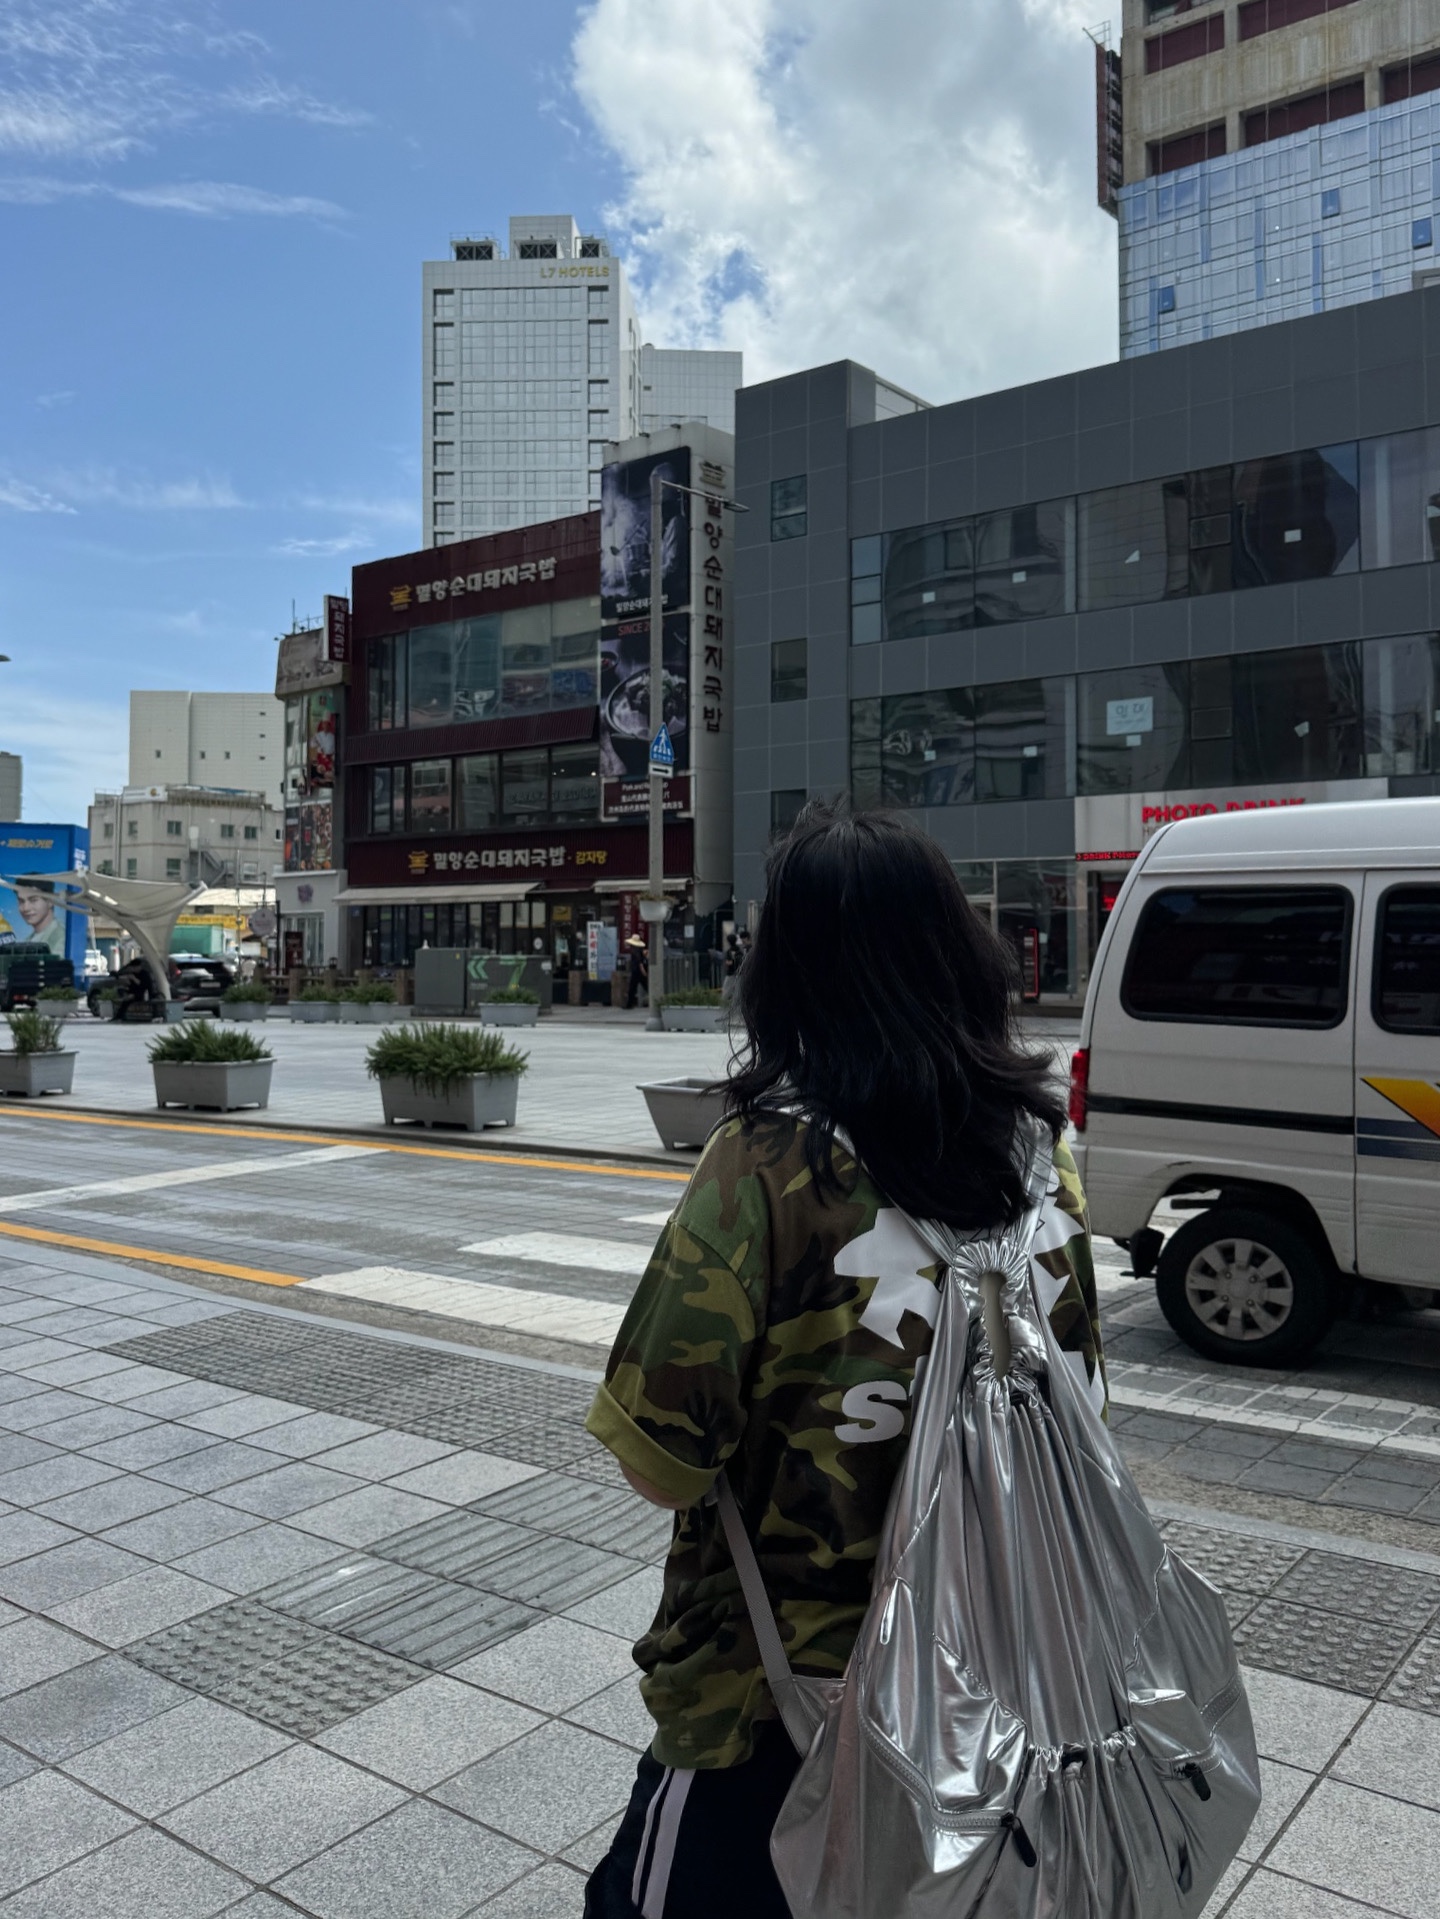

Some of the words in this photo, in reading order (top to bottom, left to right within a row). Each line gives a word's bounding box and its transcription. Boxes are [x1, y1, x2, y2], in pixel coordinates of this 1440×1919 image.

[540, 267, 555, 279] L7
[558, 265, 609, 278] HOTELS
[415, 556, 558, 603] 밀양순대돼지국밥
[618, 623, 643, 636] SINCE
[1141, 803, 1217, 823] PHOTO
[433, 846, 566, 870] 밀양순대돼지국밥
[575, 851, 608, 865] 감자탕
